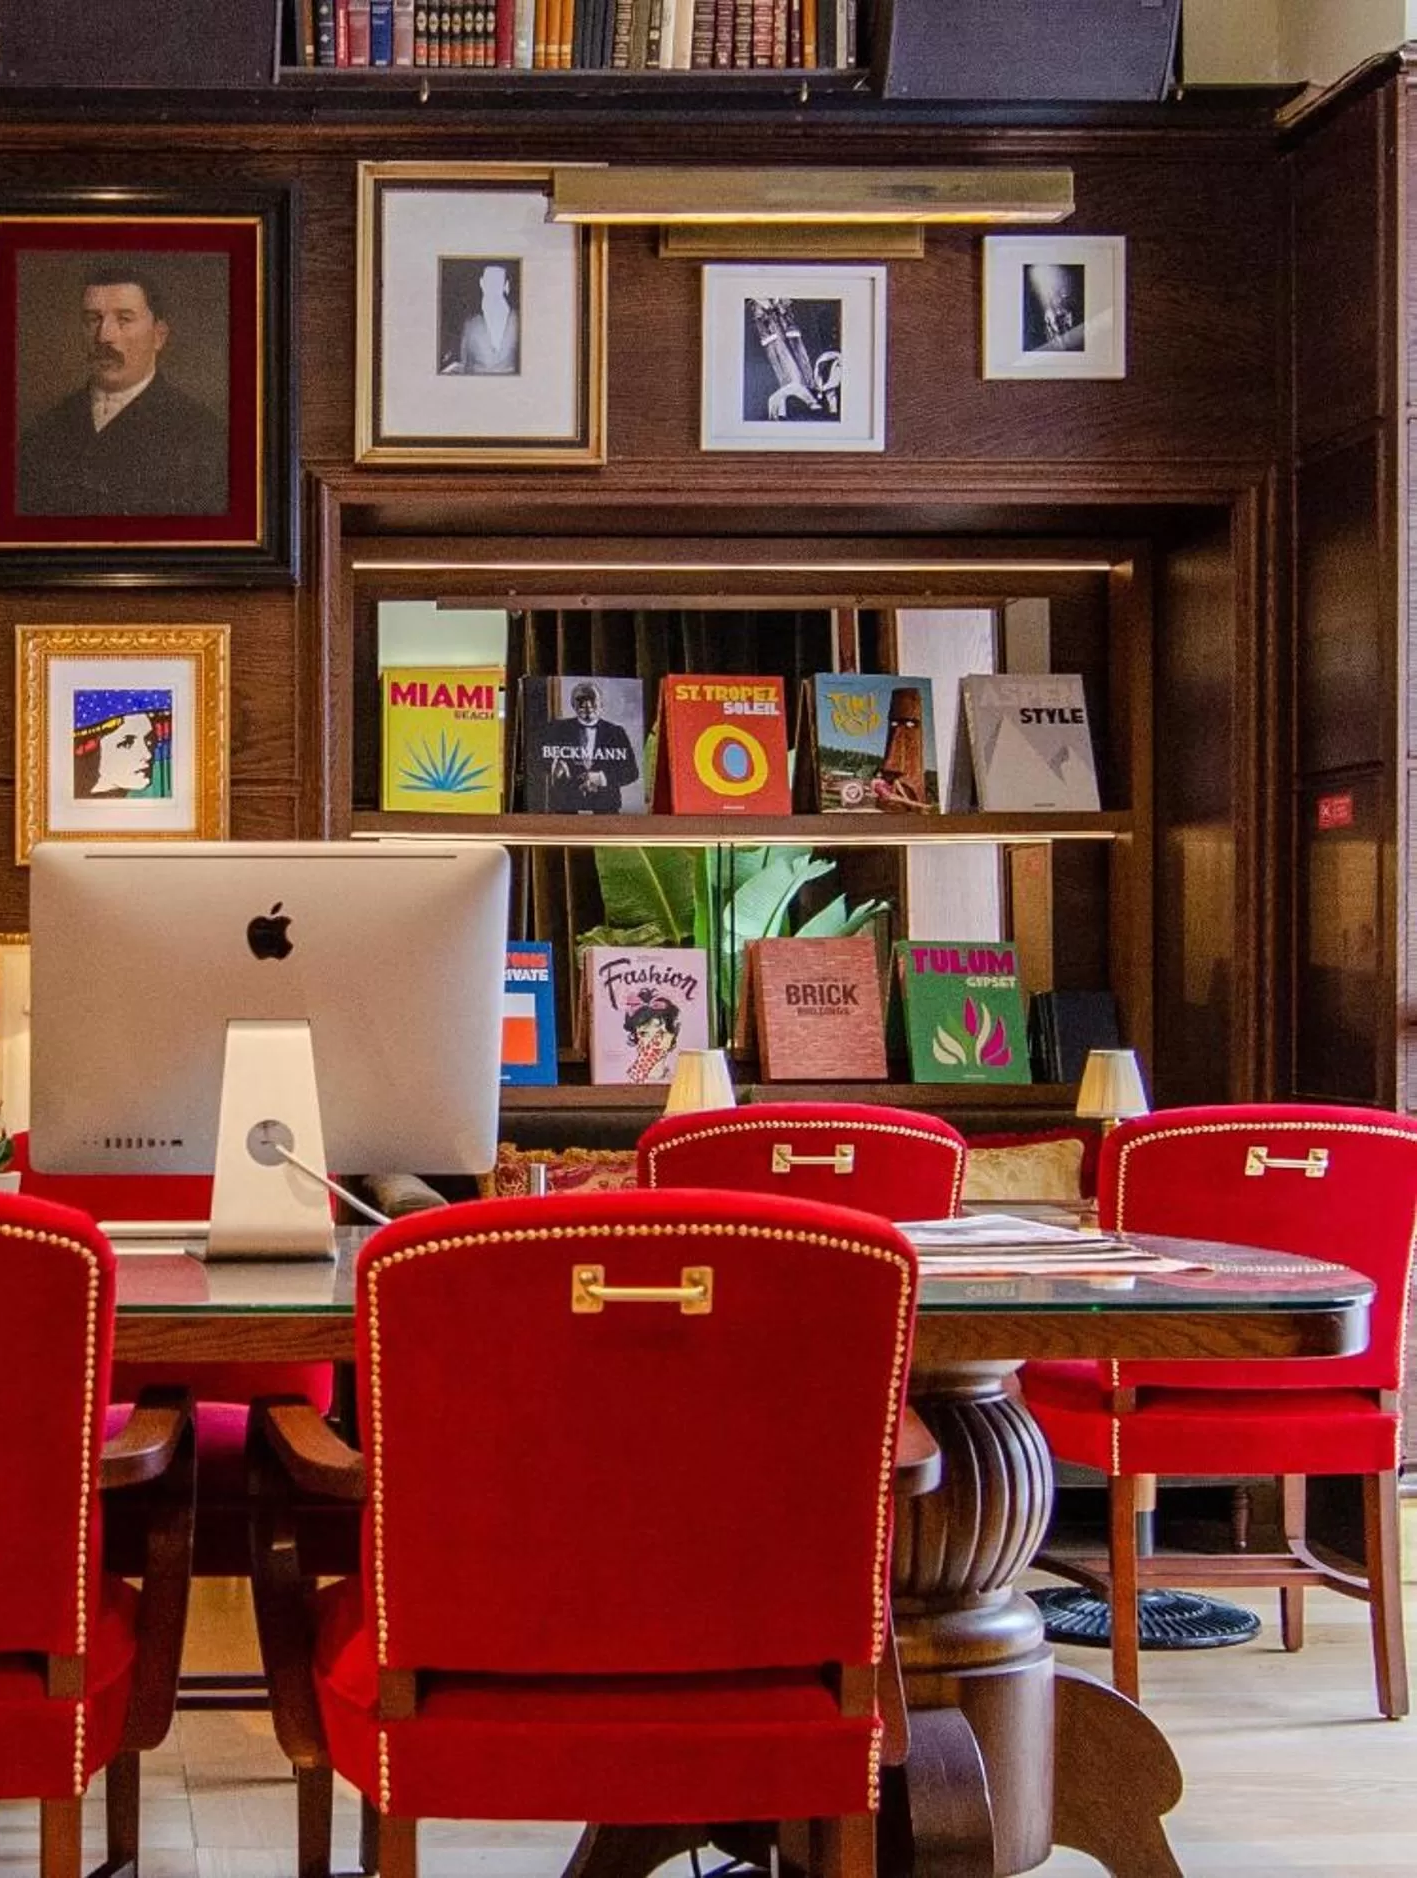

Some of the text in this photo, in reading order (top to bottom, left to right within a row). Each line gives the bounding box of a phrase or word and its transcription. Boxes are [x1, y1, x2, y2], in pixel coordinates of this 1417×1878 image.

[390, 681, 494, 709] MIAMI
[705, 685, 779, 701] TROPEZ
[454, 709, 494, 720] BEACH
[723, 701, 781, 715] SOLEIL
[1020, 708, 1084, 724] STYLE
[542, 746, 627, 760] BECKMANN
[911, 948, 1015, 974] TULUM
[506, 968, 549, 981] IVATE
[599, 957, 698, 1010] Fashion
[785, 983, 859, 1006] BRICK
